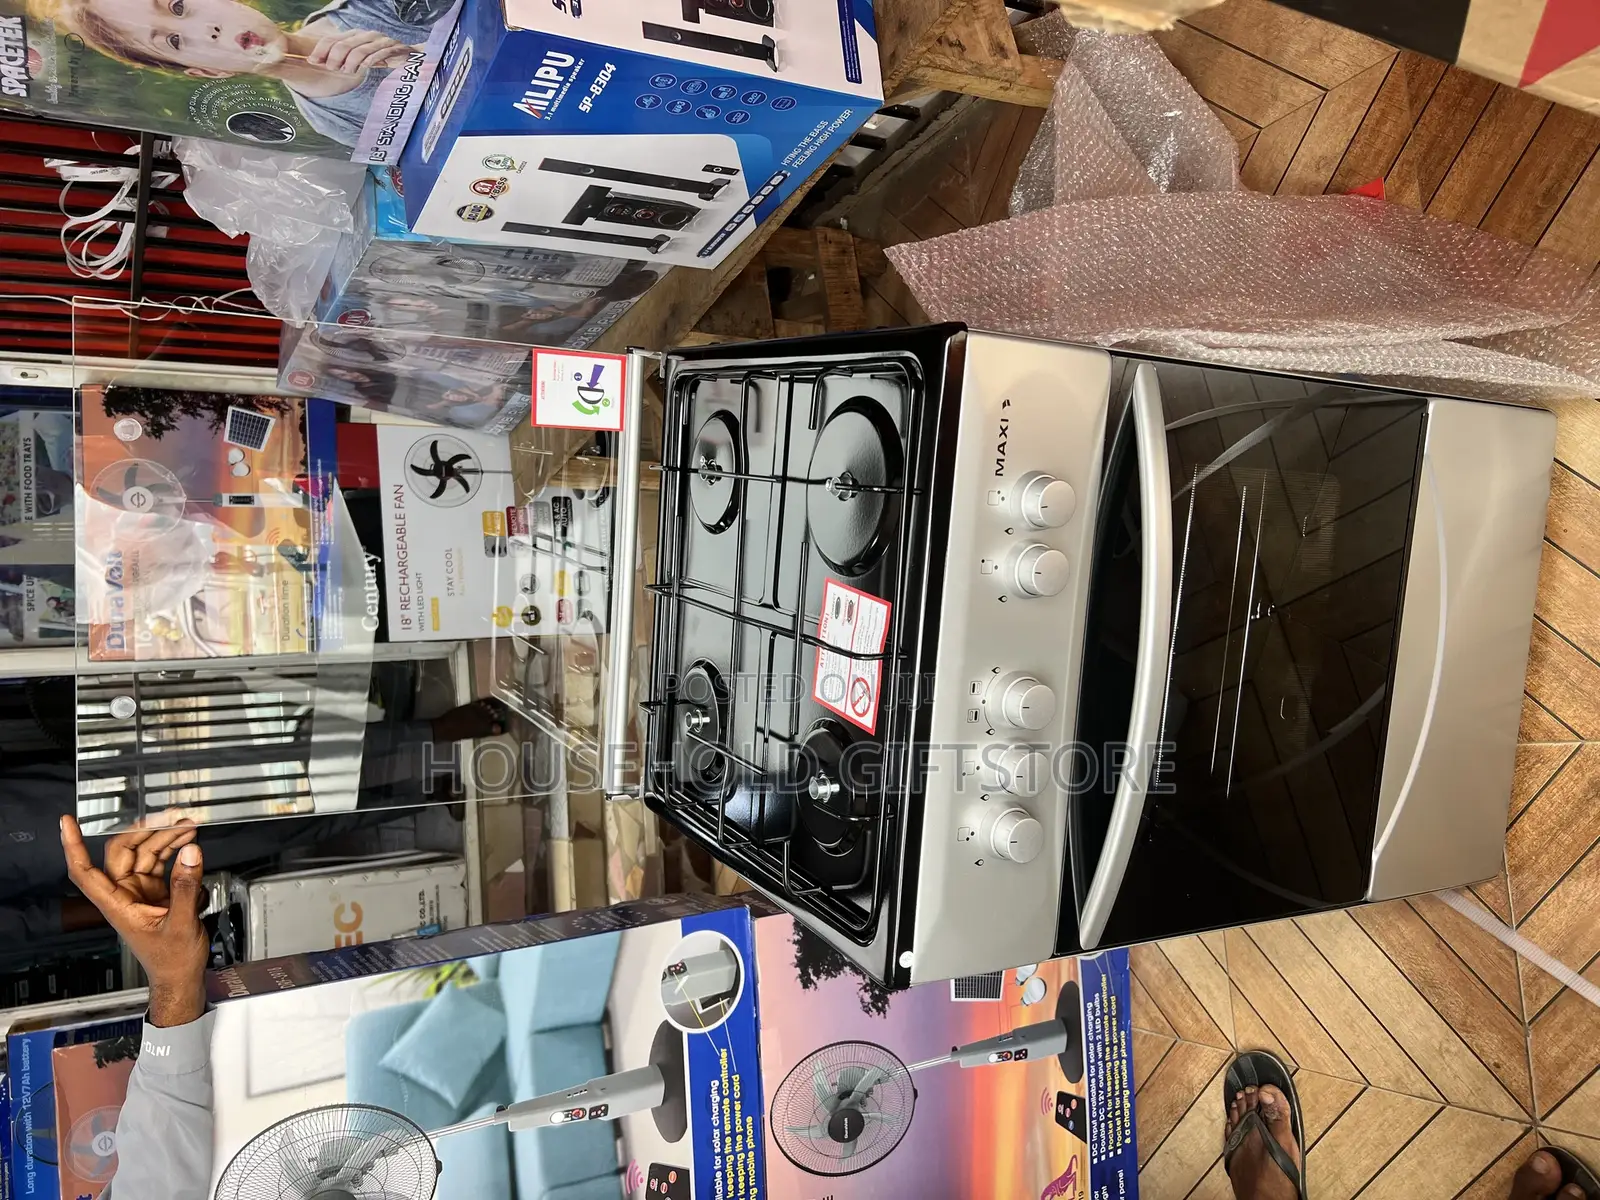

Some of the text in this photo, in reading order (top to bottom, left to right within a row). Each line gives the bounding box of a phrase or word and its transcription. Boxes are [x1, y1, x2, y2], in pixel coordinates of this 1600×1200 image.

[376, 85, 412, 146] STANDING
[400, 51, 427, 83] FAN
[512, 50, 575, 119] AILIPU
[544, 58, 585, 120] 3.1 multimedia speaker
[578, 62, 616, 114] SP-8304
[792, 145, 818, 168] FEELING
[813, 131, 832, 146] HIGH
[828, 109, 853, 132] POWER
[798, 136, 814, 148] THE
[809, 120, 829, 137] BASS
[477, 182, 492, 192] 3.1
[24, 437, 32, 464] TRAYS
[994, 418, 1009, 477] MAXI
[24, 466, 33, 490] FOOD
[25, 492, 34, 514] WITH
[394, 484, 405, 510] FAN
[395, 512, 411, 611] RECHARGEABLE
[444, 548, 456, 596] STAY COOL
[362, 554, 382, 632] Century
[416, 572, 424, 594] LIGHT
[26, 589, 36, 612] SPICE
[104, 551, 125, 651] DuraVolt
[418, 612, 426, 632] WITH
[1086, 1002, 1094, 1040] charging
[1111, 1018, 1119, 1044] power
[1095, 1042, 1103, 1059] with
[1120, 1030, 1128, 1057] phone
[1096, 1060, 1104, 1088] output
[1105, 1062, 1113, 1097] keeping
[1113, 1060, 1121, 1096] keeping
[21, 1038, 37, 1194] Long duration with 12V7Ah battery
[710, 1080, 720, 1126] charging
[1098, 1107, 1105, 1120] DC
[1122, 1089, 1131, 1128] charging
[718, 1048, 735, 1198] keeping the remote controller
[732, 1074, 745, 1196] keeping the power cord
[746, 1116, 756, 1149] phone
[712, 1129, 721, 1153] solar
[1092, 1143, 1098, 1156] DC
[713, 1156, 722, 1169] for
[746, 1151, 756, 1186] mobile
[1117, 1169, 1125, 1194] panel
